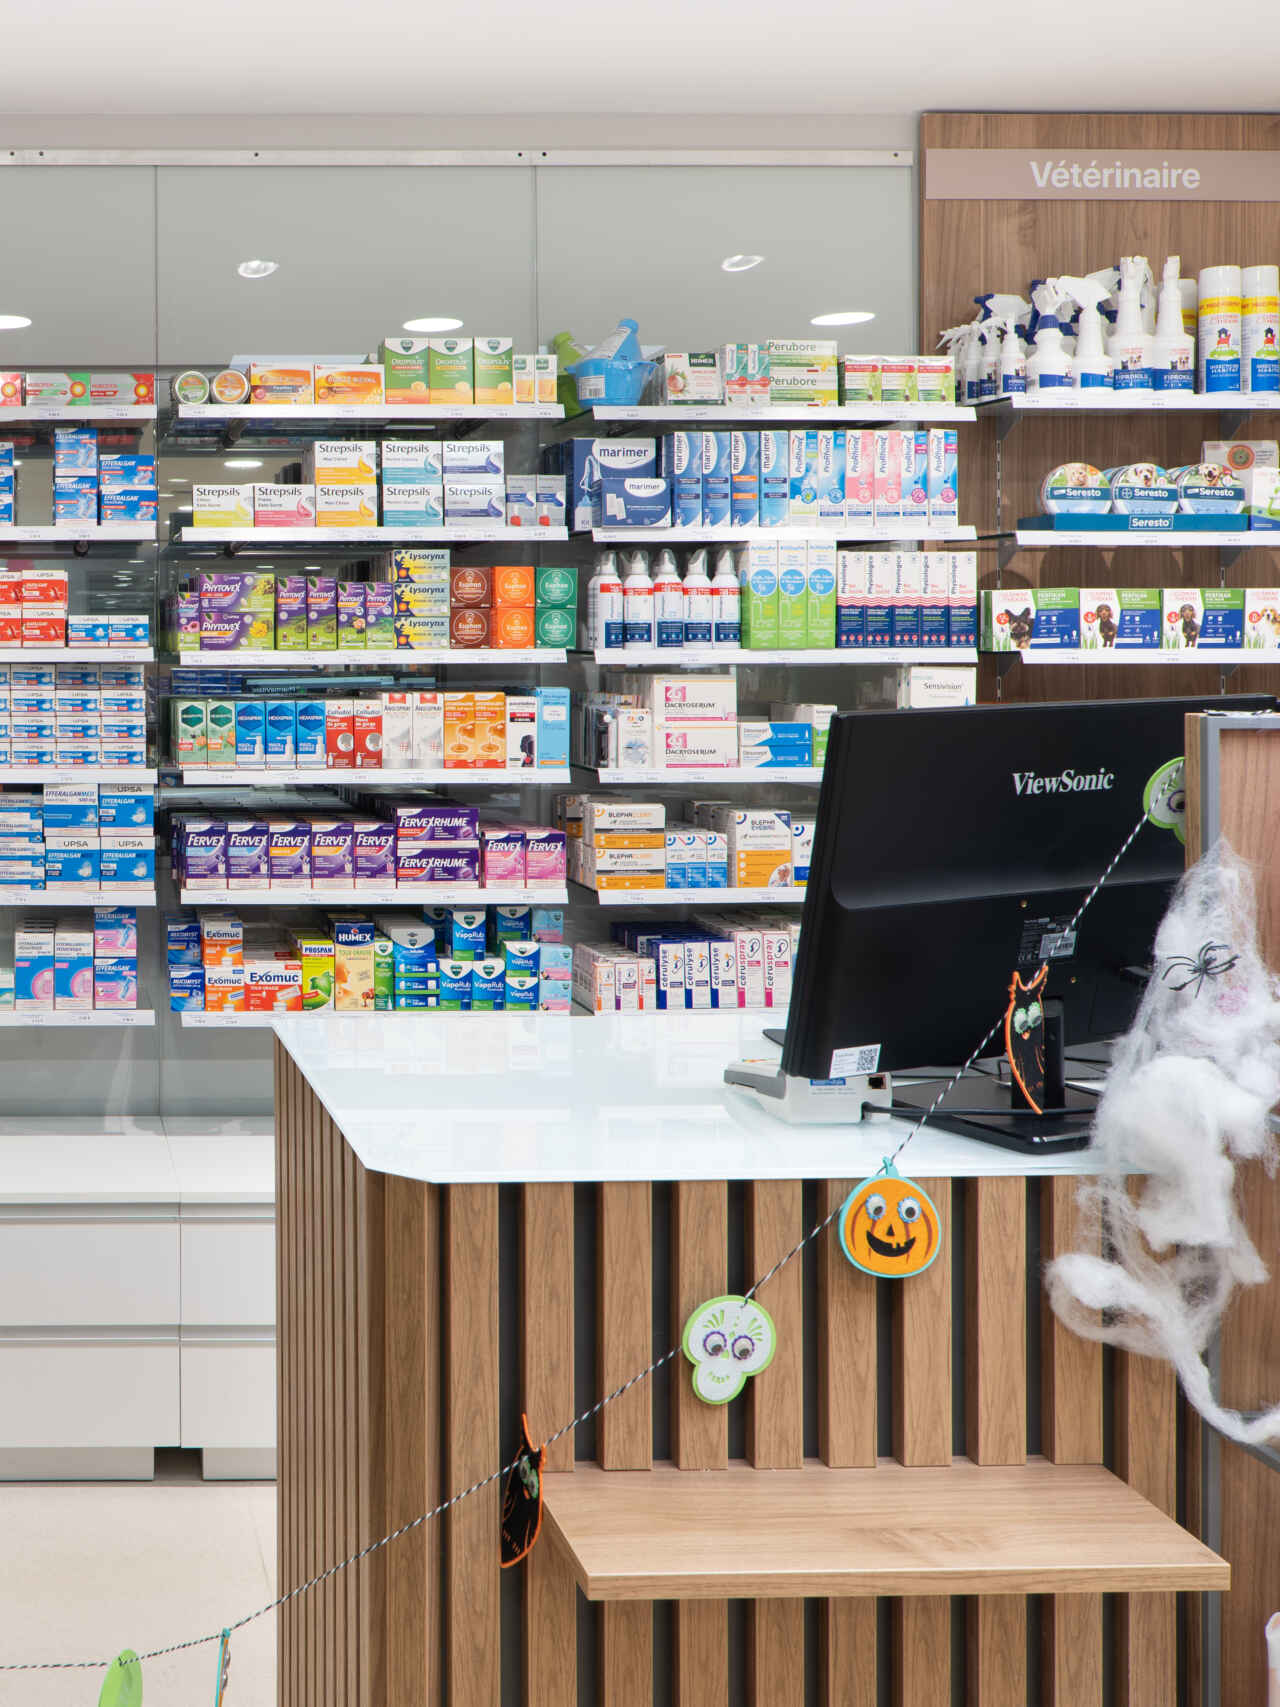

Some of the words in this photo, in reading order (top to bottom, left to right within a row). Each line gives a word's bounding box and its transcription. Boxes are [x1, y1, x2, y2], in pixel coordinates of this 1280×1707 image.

[1029, 160, 1200, 188] Vétérinaire
[769, 342, 816, 351] Perubore
[769, 377, 816, 386] Perubore
[320, 444, 363, 453] Strepsils
[386, 444, 429, 453] Strepsils
[446, 444, 490, 453] Strepsils
[599, 448, 648, 457] marimer
[197, 487, 240, 496] Strepsils
[258, 487, 302, 496] Strepsils
[320, 487, 364, 496] Strepsils
[1066, 488, 1101, 497] Seresto
[1134, 488, 1168, 498] Seresto
[1200, 487, 1234, 497] Seresto
[1132, 518, 1169, 527] Seresto
[1012, 767, 1115, 796] ViewSonic
[188, 834, 224, 846] FERVEX
[230, 834, 267, 846] FERVEX
[272, 834, 309, 846] FERVEX
[314, 834, 351, 846] FERVEX
[356, 834, 394, 846] FERVEX
[487, 841, 521, 851] FERVEX
[528, 841, 562, 851] FERVEX
[338, 933, 370, 941] HUMEX
[766, 938, 774, 987] ceruspray
[250, 971, 299, 982] Exomuc
